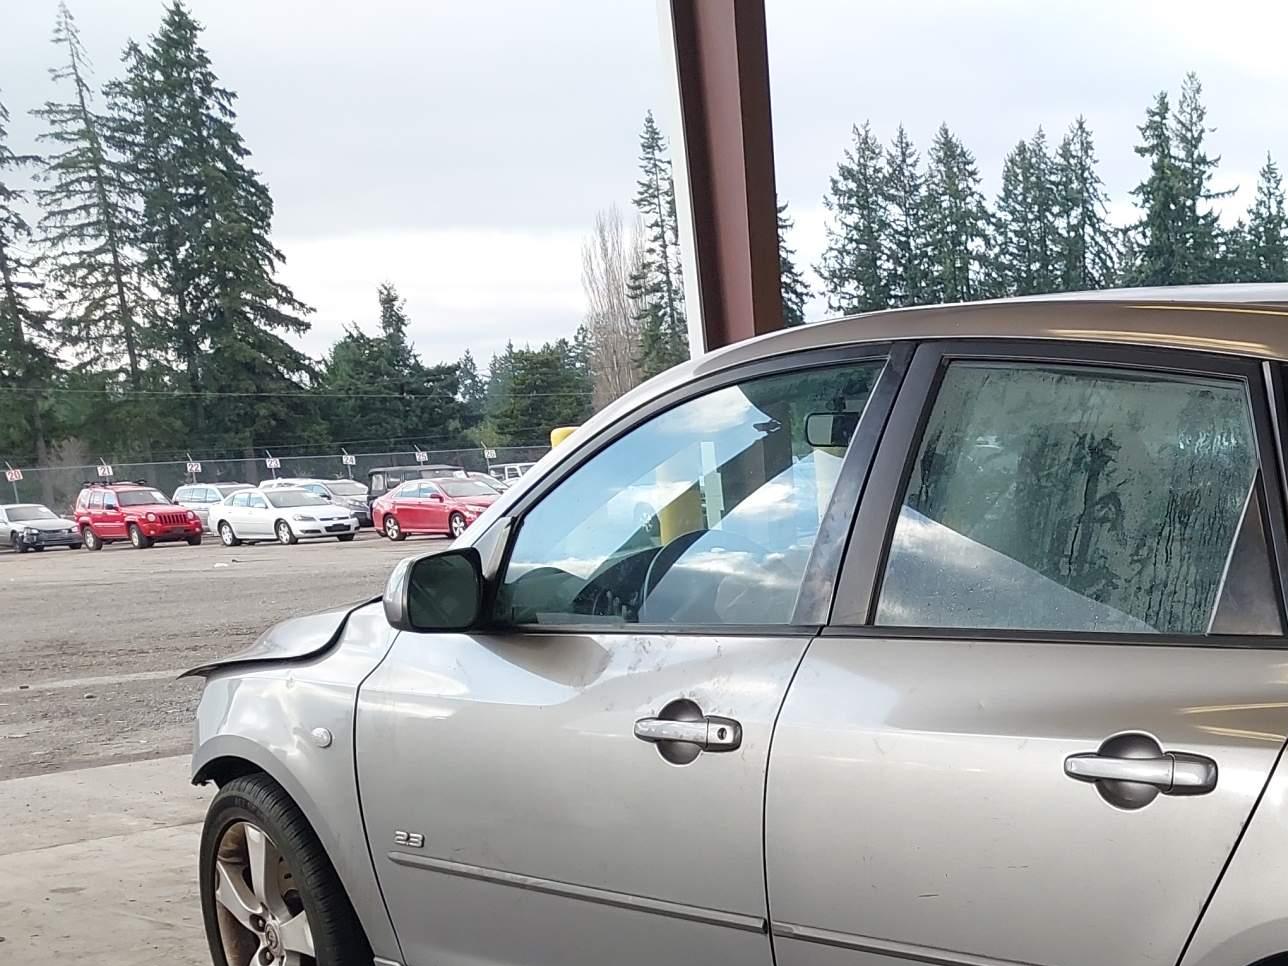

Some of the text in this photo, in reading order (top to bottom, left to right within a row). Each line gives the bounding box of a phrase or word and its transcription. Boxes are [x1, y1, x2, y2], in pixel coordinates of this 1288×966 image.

[343, 455, 355, 464] 24
[416, 452, 428, 461] 25
[268, 458, 280, 467] 23
[100, 466, 111, 476] 21
[188, 463, 201, 472] 22
[7, 470, 21, 480] 20
